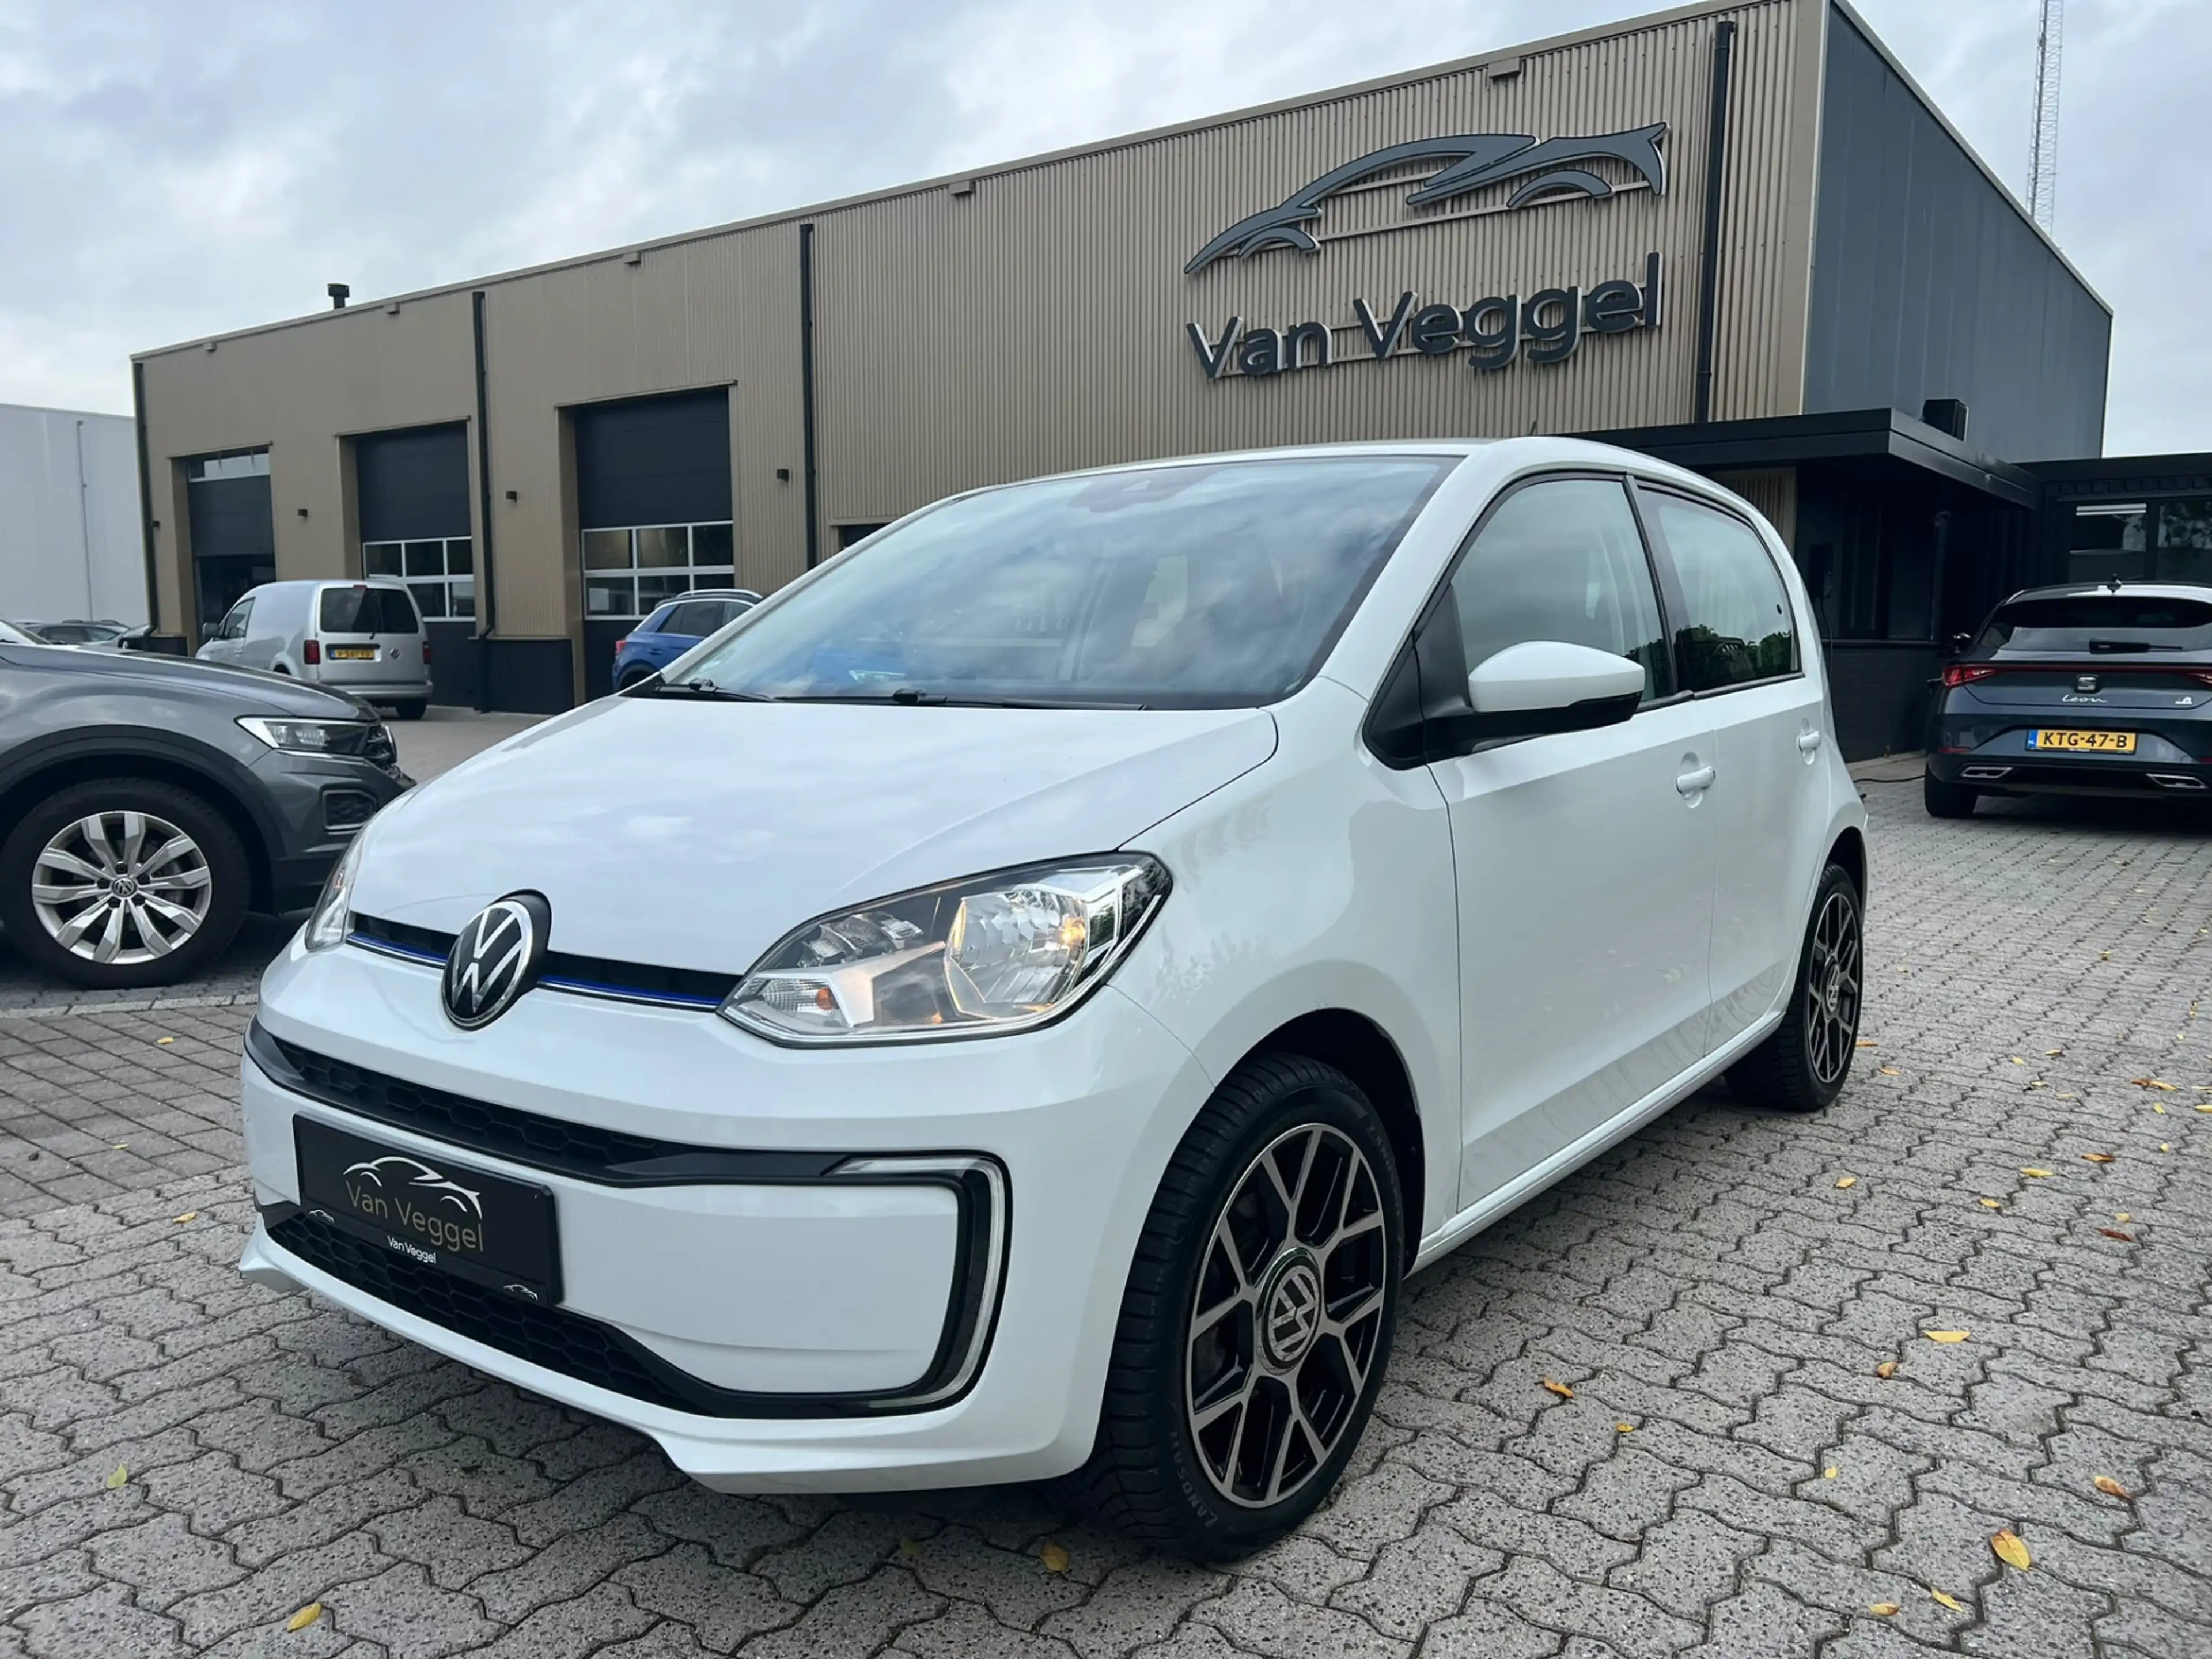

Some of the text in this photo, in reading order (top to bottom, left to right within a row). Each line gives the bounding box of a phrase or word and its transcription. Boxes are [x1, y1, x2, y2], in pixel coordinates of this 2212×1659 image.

[1186, 252, 1664, 380] Van Veggel
[2043, 732, 2127, 748] KTG-47-B
[346, 1180, 484, 1252] Van Veggel
[387, 1236, 437, 1264] Van Veggel
